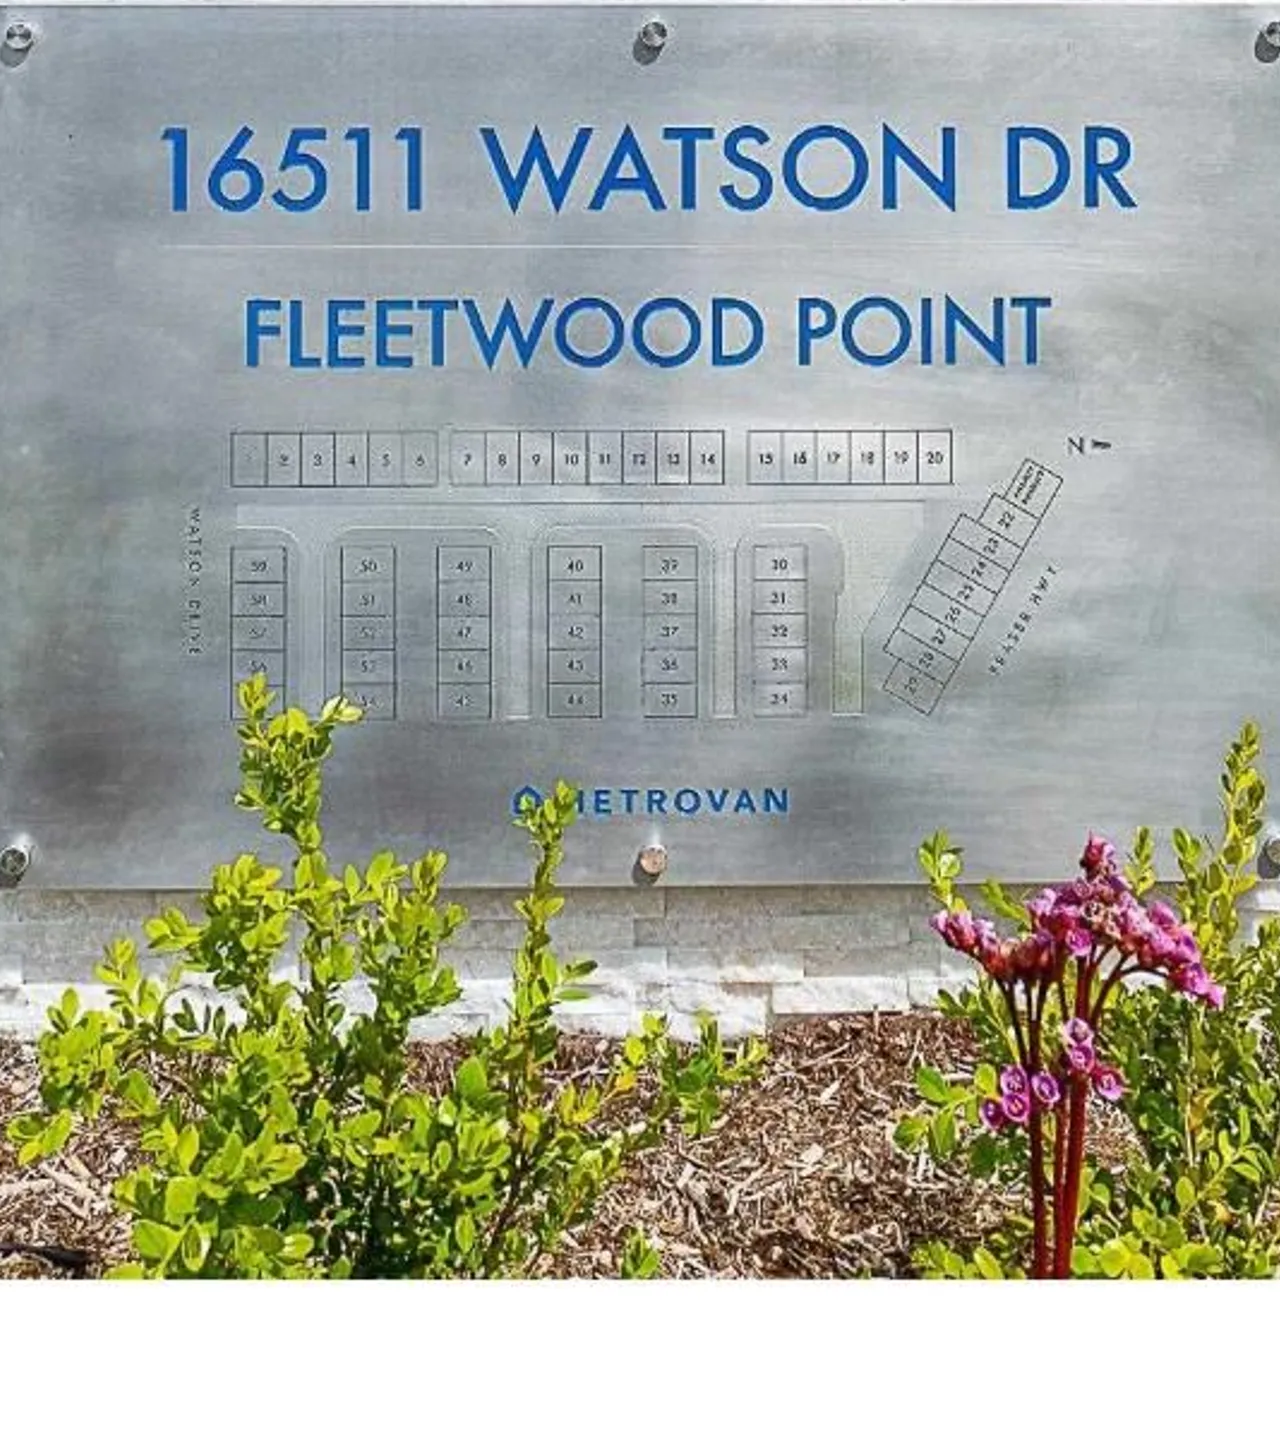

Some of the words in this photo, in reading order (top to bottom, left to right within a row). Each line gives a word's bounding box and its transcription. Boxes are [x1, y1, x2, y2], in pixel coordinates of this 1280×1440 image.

[160, 126, 424, 213] 16511
[480, 122, 957, 214] WATSON
[1006, 125, 1138, 210] DR
[245, 296, 764, 369] FLEETWOOD
[798, 292, 1052, 368] POINT
[564, 453, 580, 466] 10
[598, 453, 611, 466] 11
[758, 452, 774, 465] 15
[792, 452, 808, 465] 16
[827, 452, 841, 465] 17
[860, 452, 875, 465] 18
[893, 452, 910, 465] 19
[926, 452, 945, 465] 20
[983, 537, 1000, 554] 23
[567, 559, 584, 572] 40
[567, 593, 584, 605] 41
[567, 626, 584, 639] 42
[661, 626, 678, 638] 37
[931, 628, 947, 645] 27
